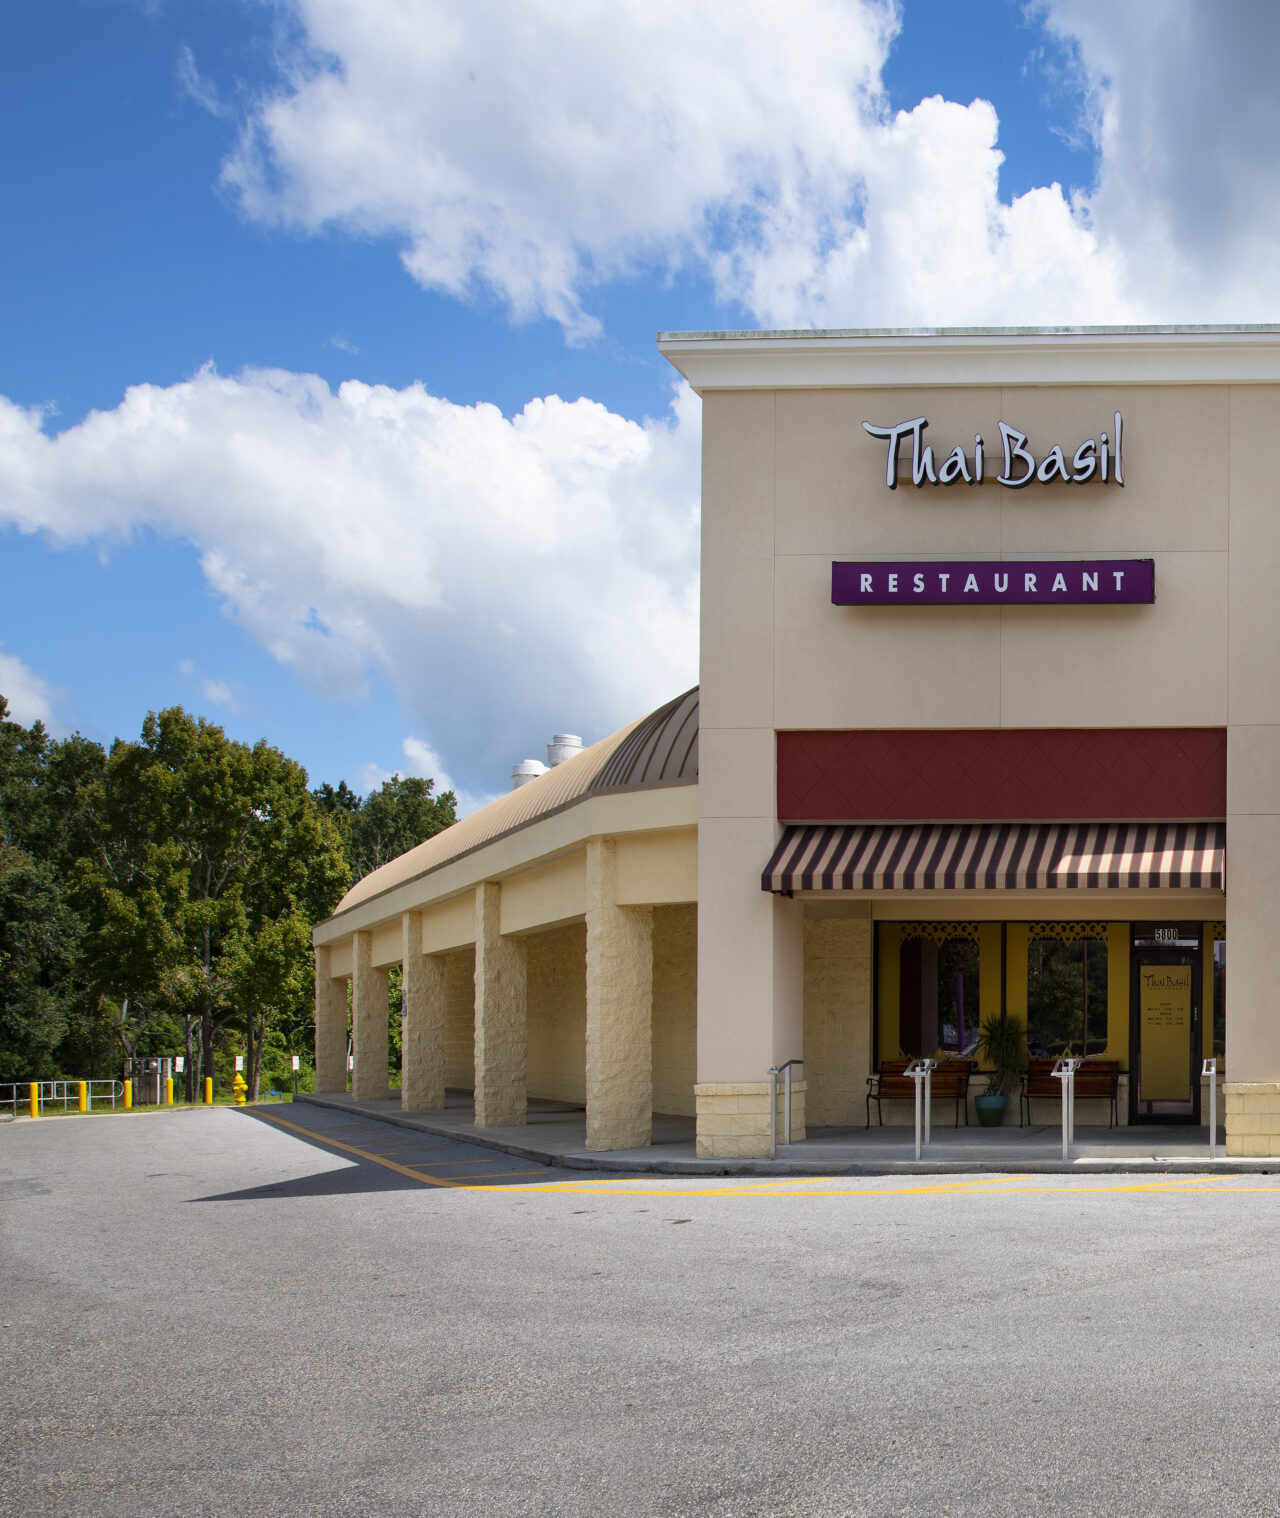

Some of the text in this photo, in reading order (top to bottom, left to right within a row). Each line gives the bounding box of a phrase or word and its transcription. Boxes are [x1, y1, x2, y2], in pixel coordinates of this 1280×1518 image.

[861, 410, 1125, 489] Thai Basil
[860, 571, 1124, 593] RESTAURANT
[1156, 929, 1177, 940] 5800
